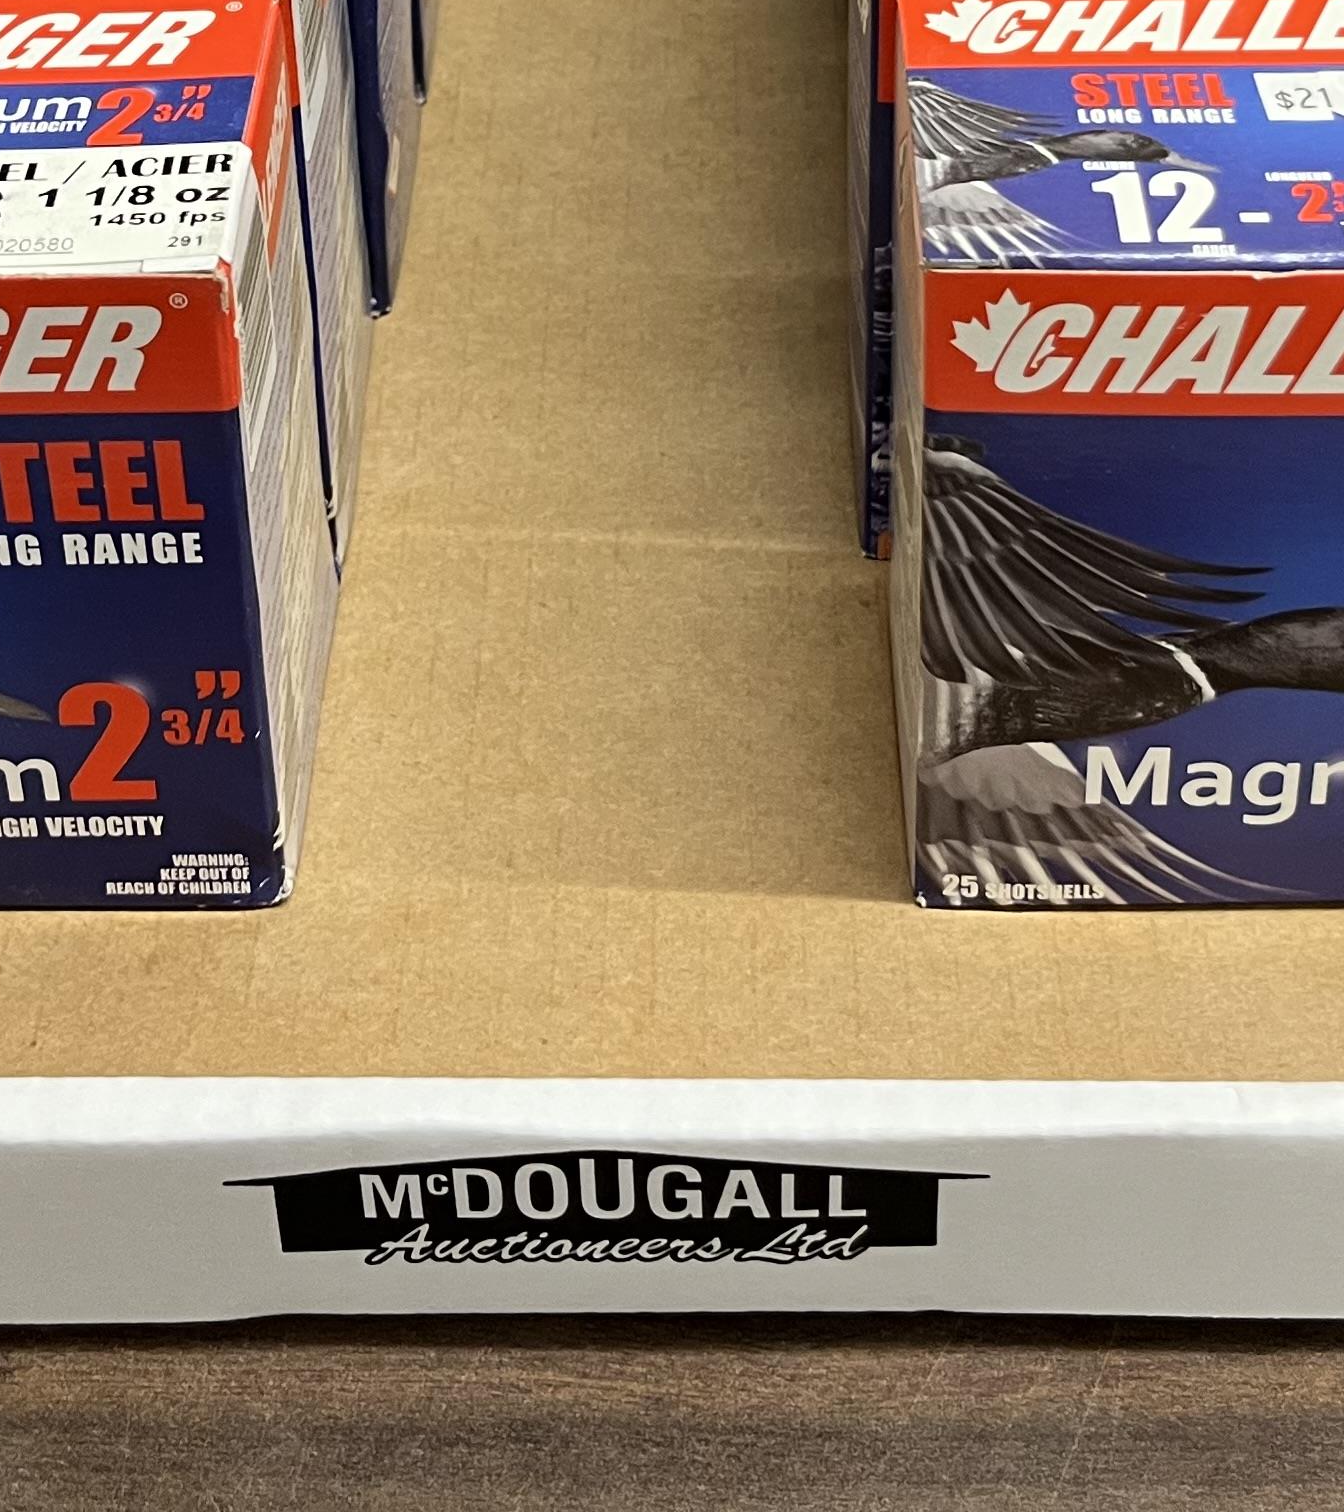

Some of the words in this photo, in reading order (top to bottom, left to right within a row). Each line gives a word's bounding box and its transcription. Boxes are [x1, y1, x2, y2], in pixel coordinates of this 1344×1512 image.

[1070, 72, 1236, 110] STEEL
[9, 118, 88, 135] VELOCITY
[86, 87, 156, 147] 2
[152, 103, 206, 123] 3/4
[1077, 107, 1143, 125] LONG
[1154, 107, 1237, 125] RANGE
[102, 153, 235, 178] ACIER
[85, 186, 155, 208] 1/8
[175, 187, 231, 205] oz
[1091, 170, 1225, 244] 12
[89, 210, 167, 228] 1450
[178, 210, 227, 228] fps
[64, 532, 205, 566] RANGE
[58, 681, 158, 802] 2
[161, 708, 246, 746] 3/4
[45, 815, 164, 837] VELOCITY
[171, 853, 250, 867] WARNING:
[160, 868, 196, 881] KEEP
[198, 867, 229, 880] OUT
[231, 867, 251, 880] OF
[942, 873, 979, 898] 25
[984, 882, 1106, 900] SHOTSHELLS
[106, 881, 155, 895] REACH
[158, 881, 177, 895] OF
[179, 880, 252, 895] CHILDREN
[358, 1157, 868, 1221] McDOUGALL
[369, 1224, 732, 1264] Auctioneers
[740, 1223, 872, 1264] Ltd
